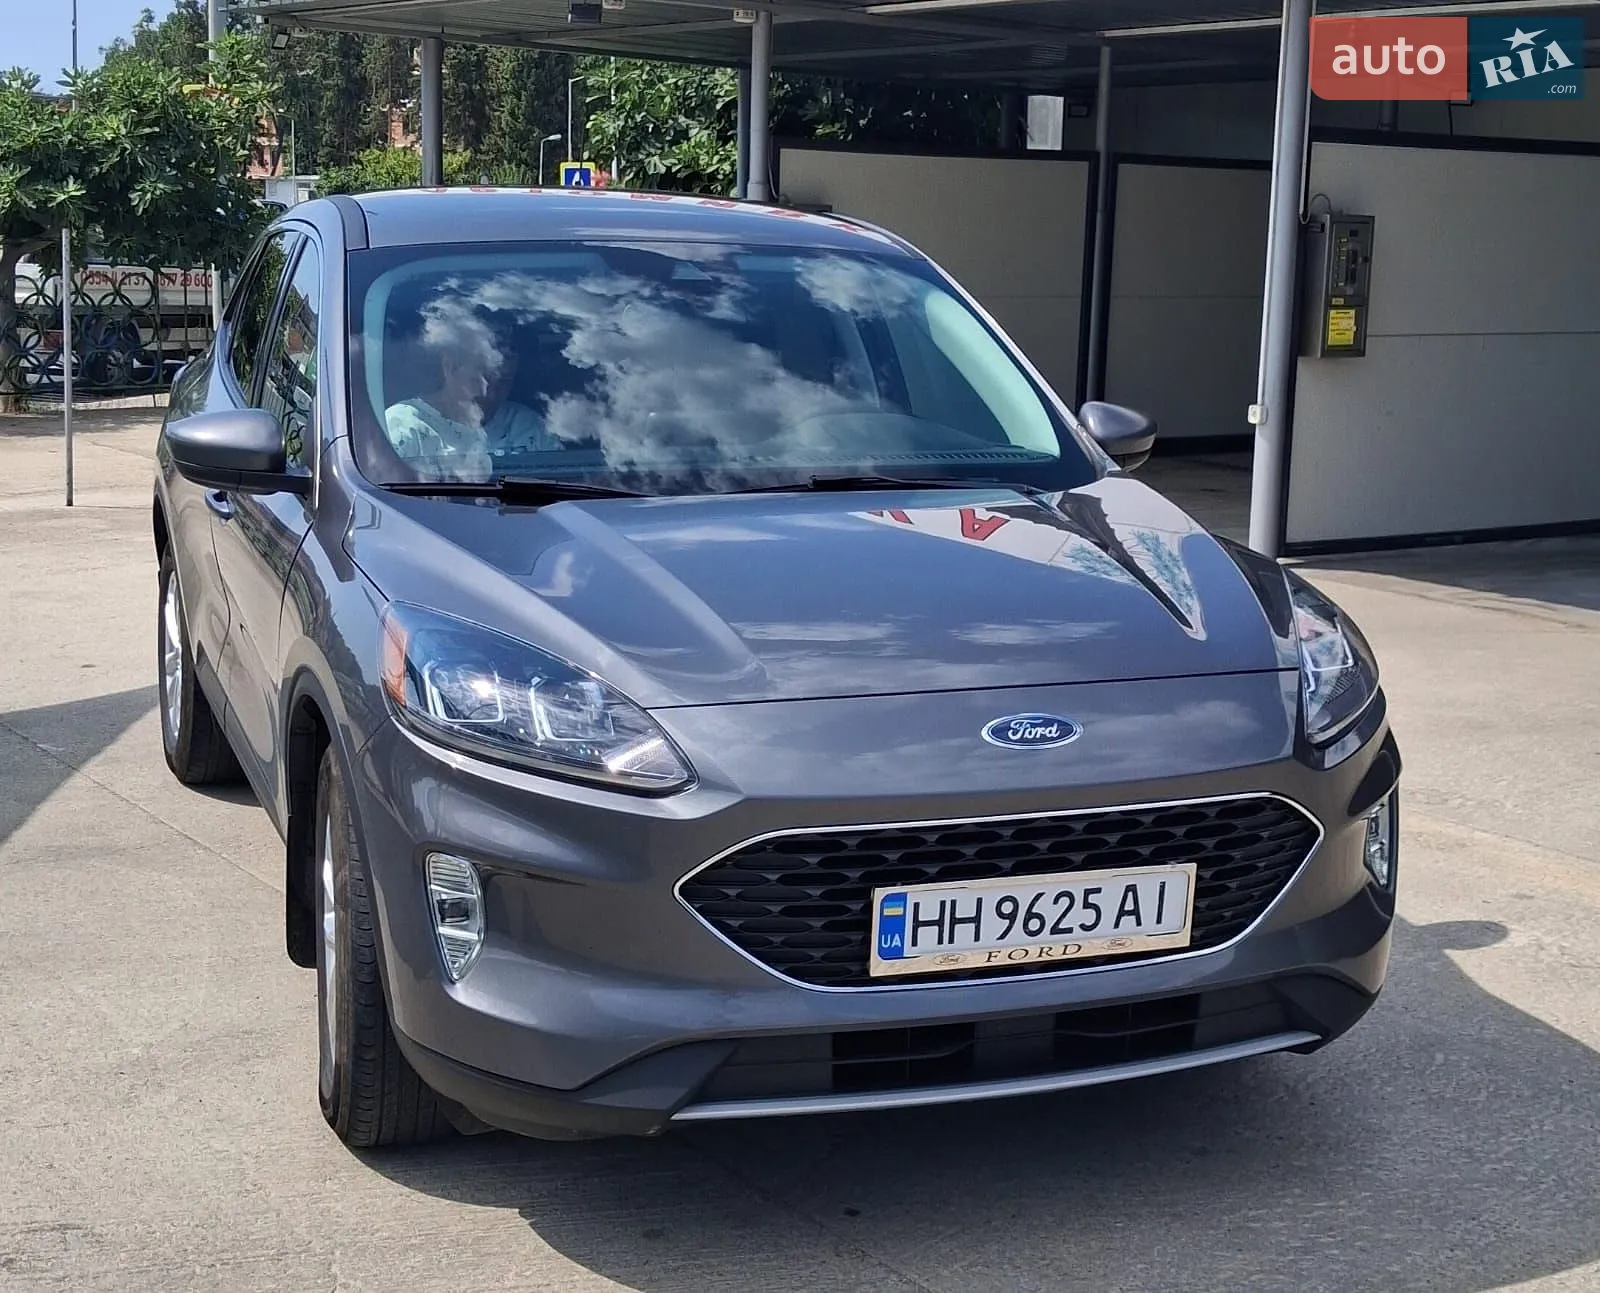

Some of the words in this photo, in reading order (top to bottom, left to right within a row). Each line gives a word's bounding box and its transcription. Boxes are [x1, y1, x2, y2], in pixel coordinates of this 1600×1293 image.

[1008, 719, 1060, 740] Ford
[911, 897, 983, 947] HH
[995, 887, 1103, 941] 9625
[882, 934, 902, 948] UA
[984, 943, 1082, 963] FORD
